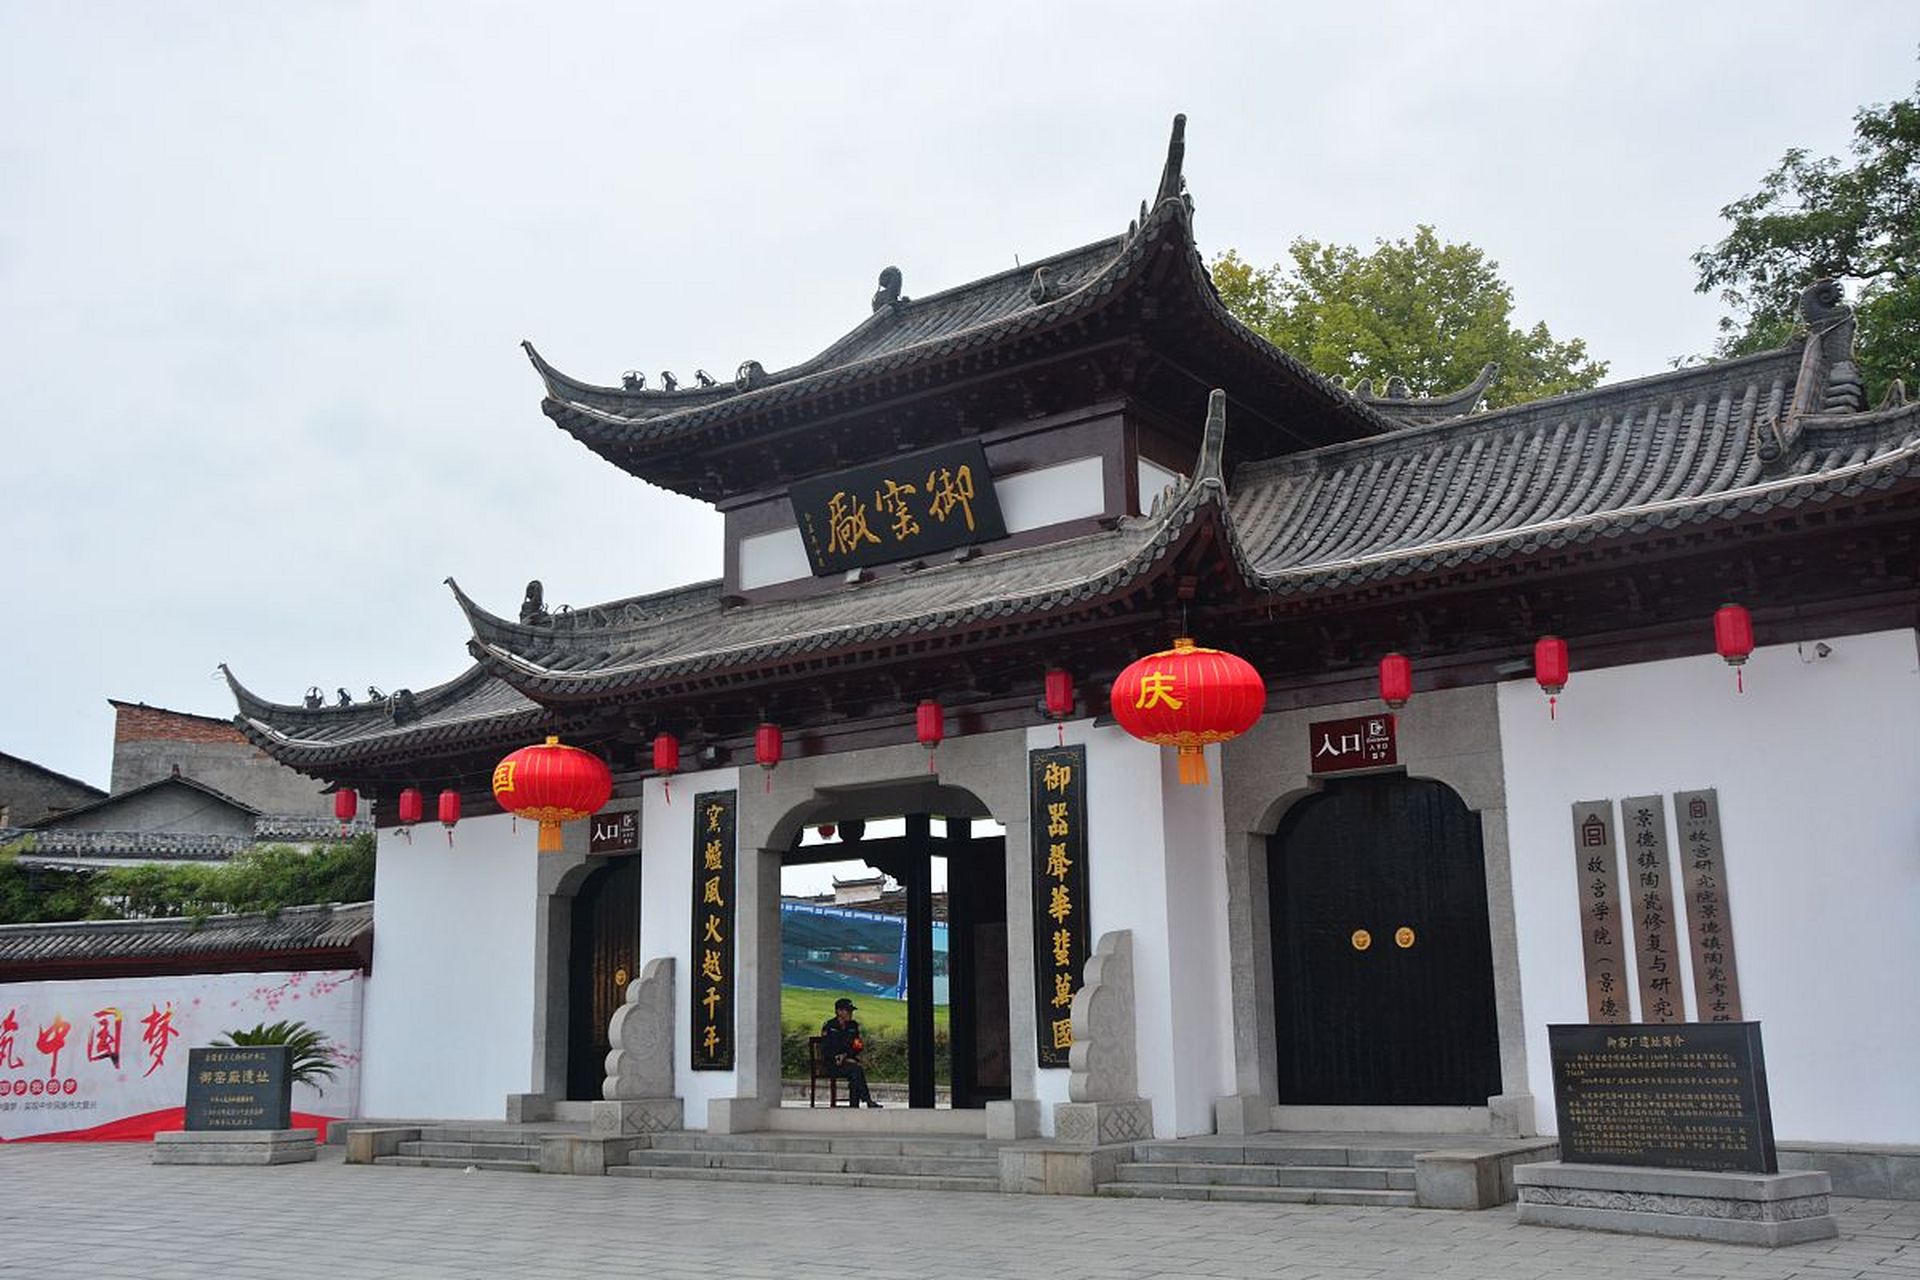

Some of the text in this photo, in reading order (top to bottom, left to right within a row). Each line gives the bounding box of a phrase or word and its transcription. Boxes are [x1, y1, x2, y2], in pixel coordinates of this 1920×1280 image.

[1135, 671, 1183, 710] 庆
[1316, 733, 1360, 758] 入口
[492, 760, 516, 796] 国
[592, 823, 618, 842] 入口
[1632, 808, 1674, 1022] 景德镇陶瓷修复与研究
[1587, 856, 1620, 1022] 故宫学院（景德
